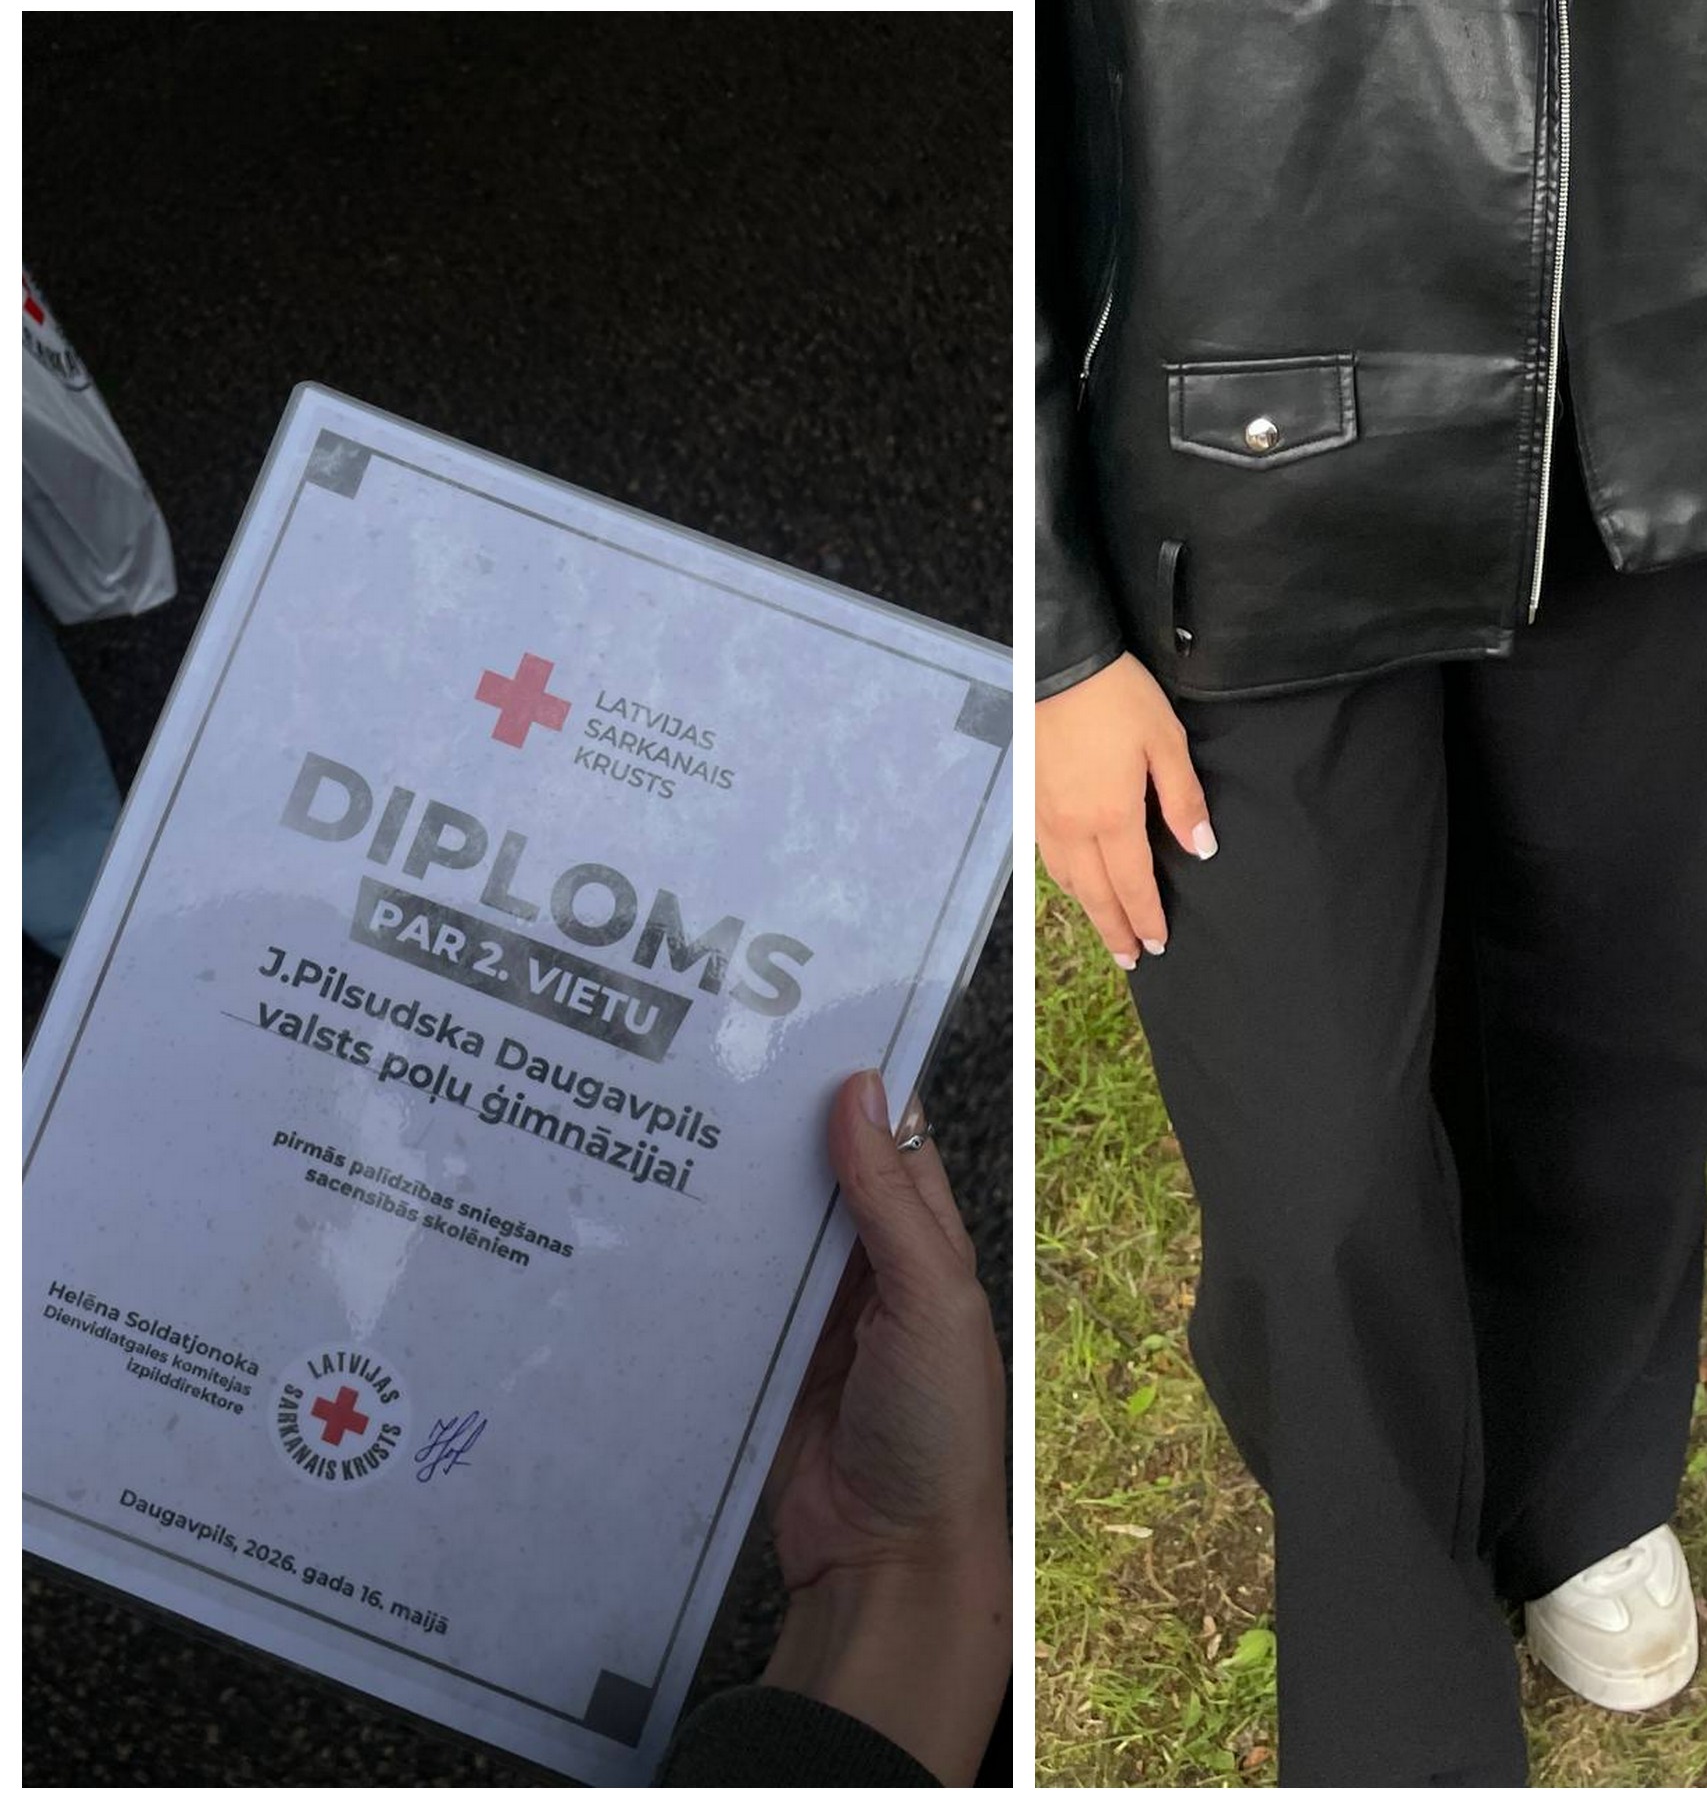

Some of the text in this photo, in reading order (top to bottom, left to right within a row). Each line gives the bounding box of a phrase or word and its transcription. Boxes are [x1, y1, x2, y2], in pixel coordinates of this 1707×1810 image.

[585, 718, 735, 790] SARKANAIS
[596, 689, 716, 750] LATVIJAS
[574, 745, 677, 800] KRUSTS
[279, 751, 815, 1017] DIPLOMS
[368, 898, 660, 1037] PAR 2. VIETU
[258, 946, 722, 1150] J.Pilsudska Daugavpils
[258, 1002, 695, 1192] valsts poļu ģimnāzijai
[273, 1130, 575, 1259] pirmās palīdzības sniegšanas
[305, 1167, 530, 1268] sacensībās skolēniem
[42, 1303, 252, 1397] Dienvidlatgales komitejas
[48, 1280, 260, 1377] Helēna Soldatjonoka
[126, 1357, 244, 1416] izpilddirektore
[307, 1351, 401, 1406] LATVIJAS
[277, 1383, 337, 1481] SARKANAIS
[341, 1422, 402, 1482] KRUSTS
[119, 1489, 450, 1636] Daugavpils, 2026. gada 16. maijā
